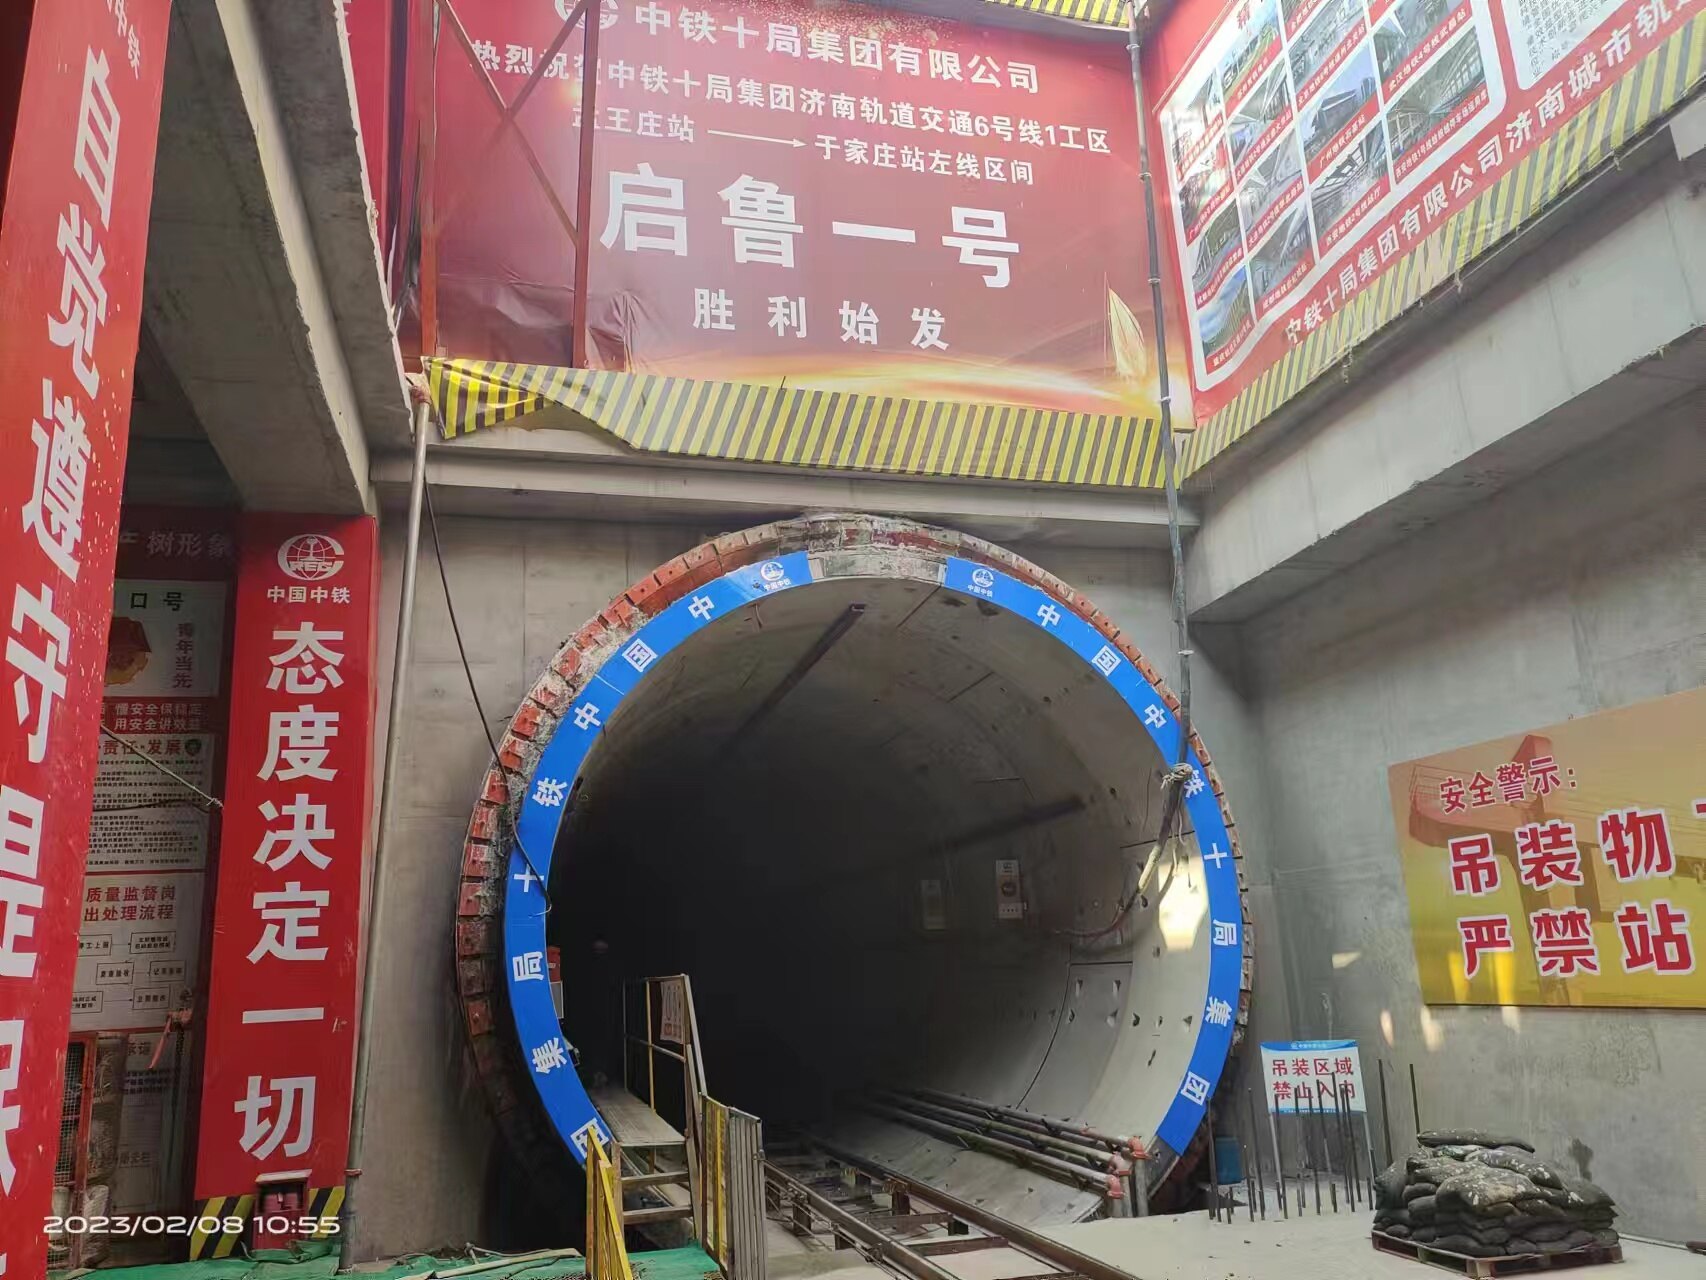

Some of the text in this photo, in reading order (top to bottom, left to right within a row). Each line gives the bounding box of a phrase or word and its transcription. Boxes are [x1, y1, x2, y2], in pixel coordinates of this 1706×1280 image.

[635, 2, 1041, 95] 中铁十局集团有限公司
[814, 134, 1034, 186] 于家庄站左线区间
[1283, 0, 1691, 345] 中铁十局集团有限公司济南城市轨
[600, 162, 1019, 288] 启鲁一号
[693, 288, 948, 351] 胜利始发
[267, 585, 351, 604] 中国中铁
[1448, 799, 1706, 896] 吊装物
[84, 904, 174, 922] 出处理流程
[86, 884, 176, 903] 质量监督岗
[234, 621, 345, 1162] 态度决定一切
[1458, 901, 1696, 979] 严禁站
[1272, 1056, 1354, 1077] 吊装区域
[1272, 1080, 1356, 1100] 禁止入内
